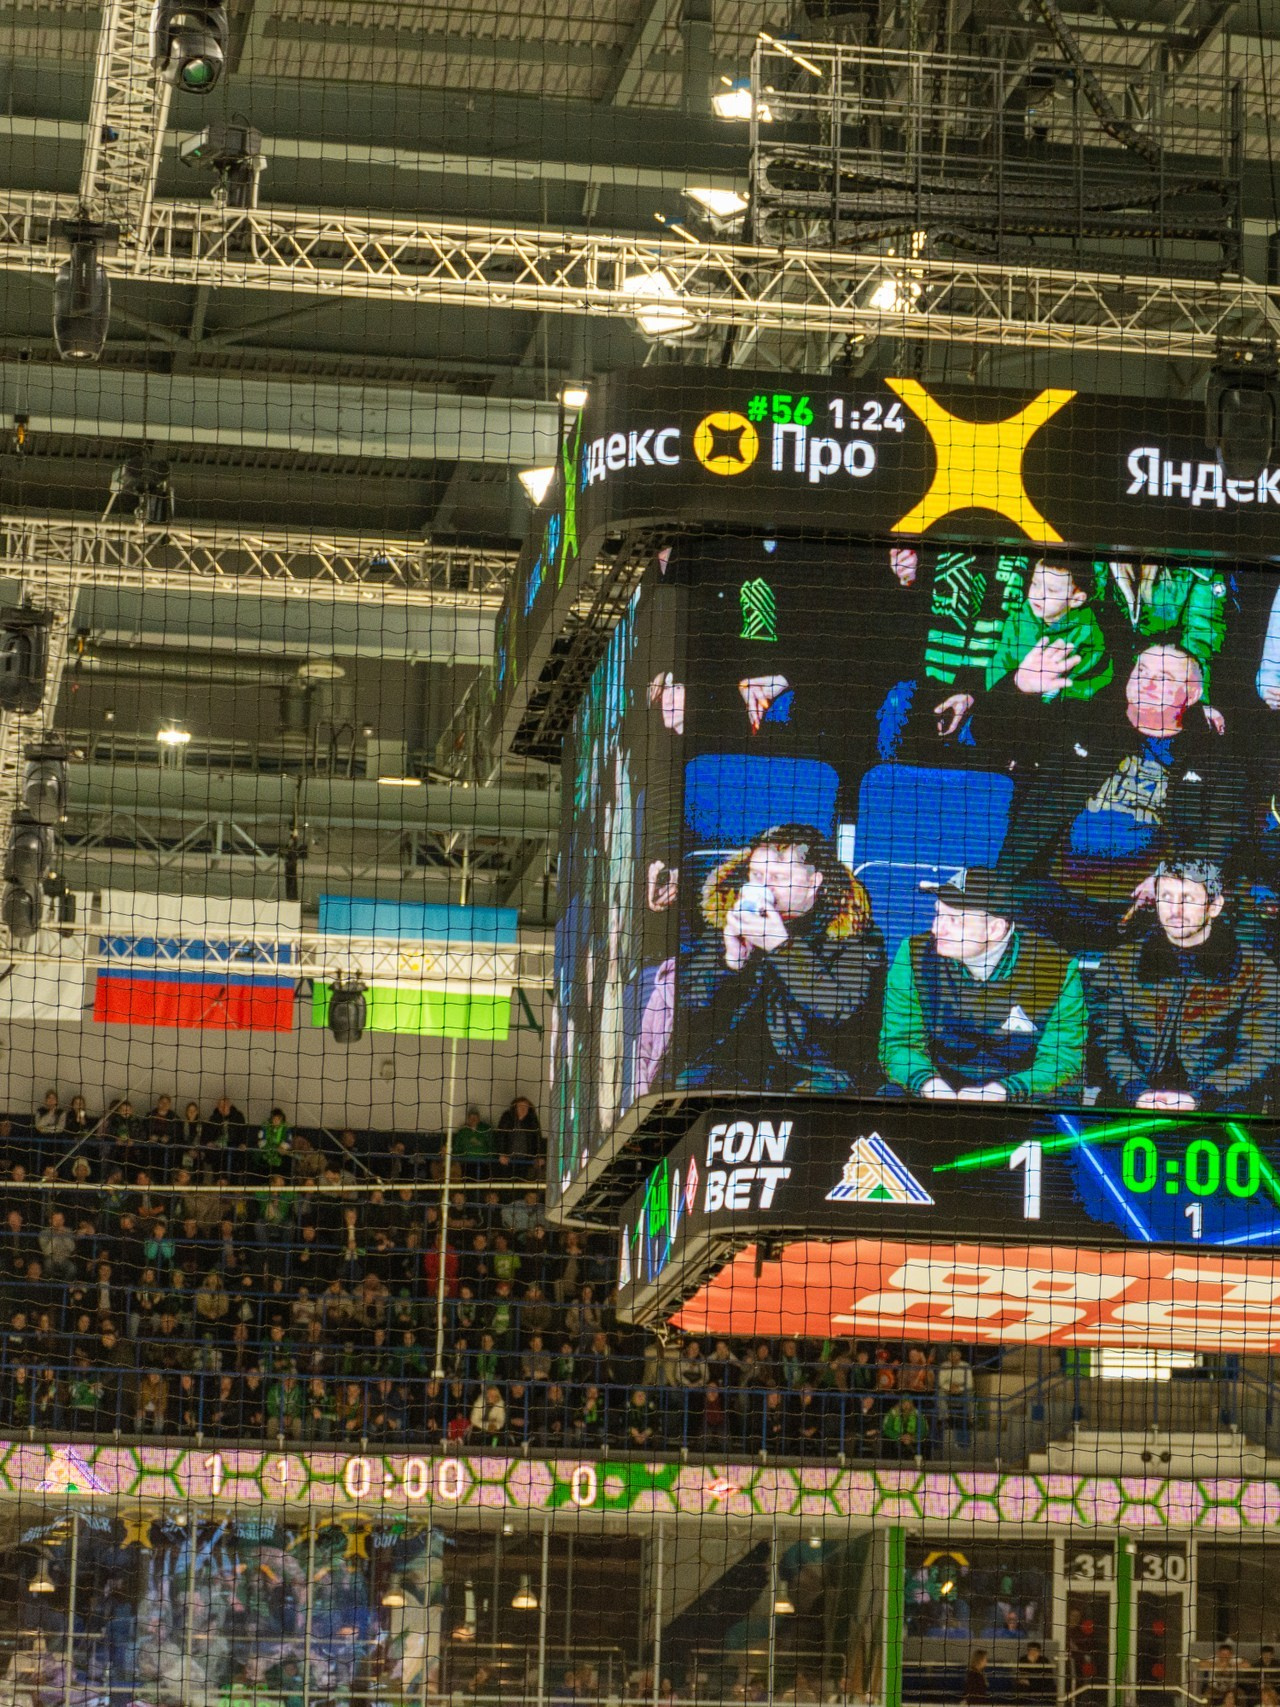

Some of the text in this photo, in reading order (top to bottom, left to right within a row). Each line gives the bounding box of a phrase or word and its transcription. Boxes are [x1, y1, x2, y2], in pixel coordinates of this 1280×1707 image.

[748, 394, 905, 432] #56 1:24
[771, 423, 876, 483] Про
[706, 1121, 793, 1167] FON
[1009, 1140, 1041, 1219] 1
[1122, 1136, 1260, 1198] 0:00
[704, 1167, 791, 1214] BET
[1184, 1202, 1203, 1238] 1
[204, 1453, 221, 1496] 1
[345, 1456, 465, 1500] 0:00
[571, 1465, 597, 1507] 0
[1074, 1553, 1113, 1580] 31
[1142, 1554, 1186, 1580] 30
